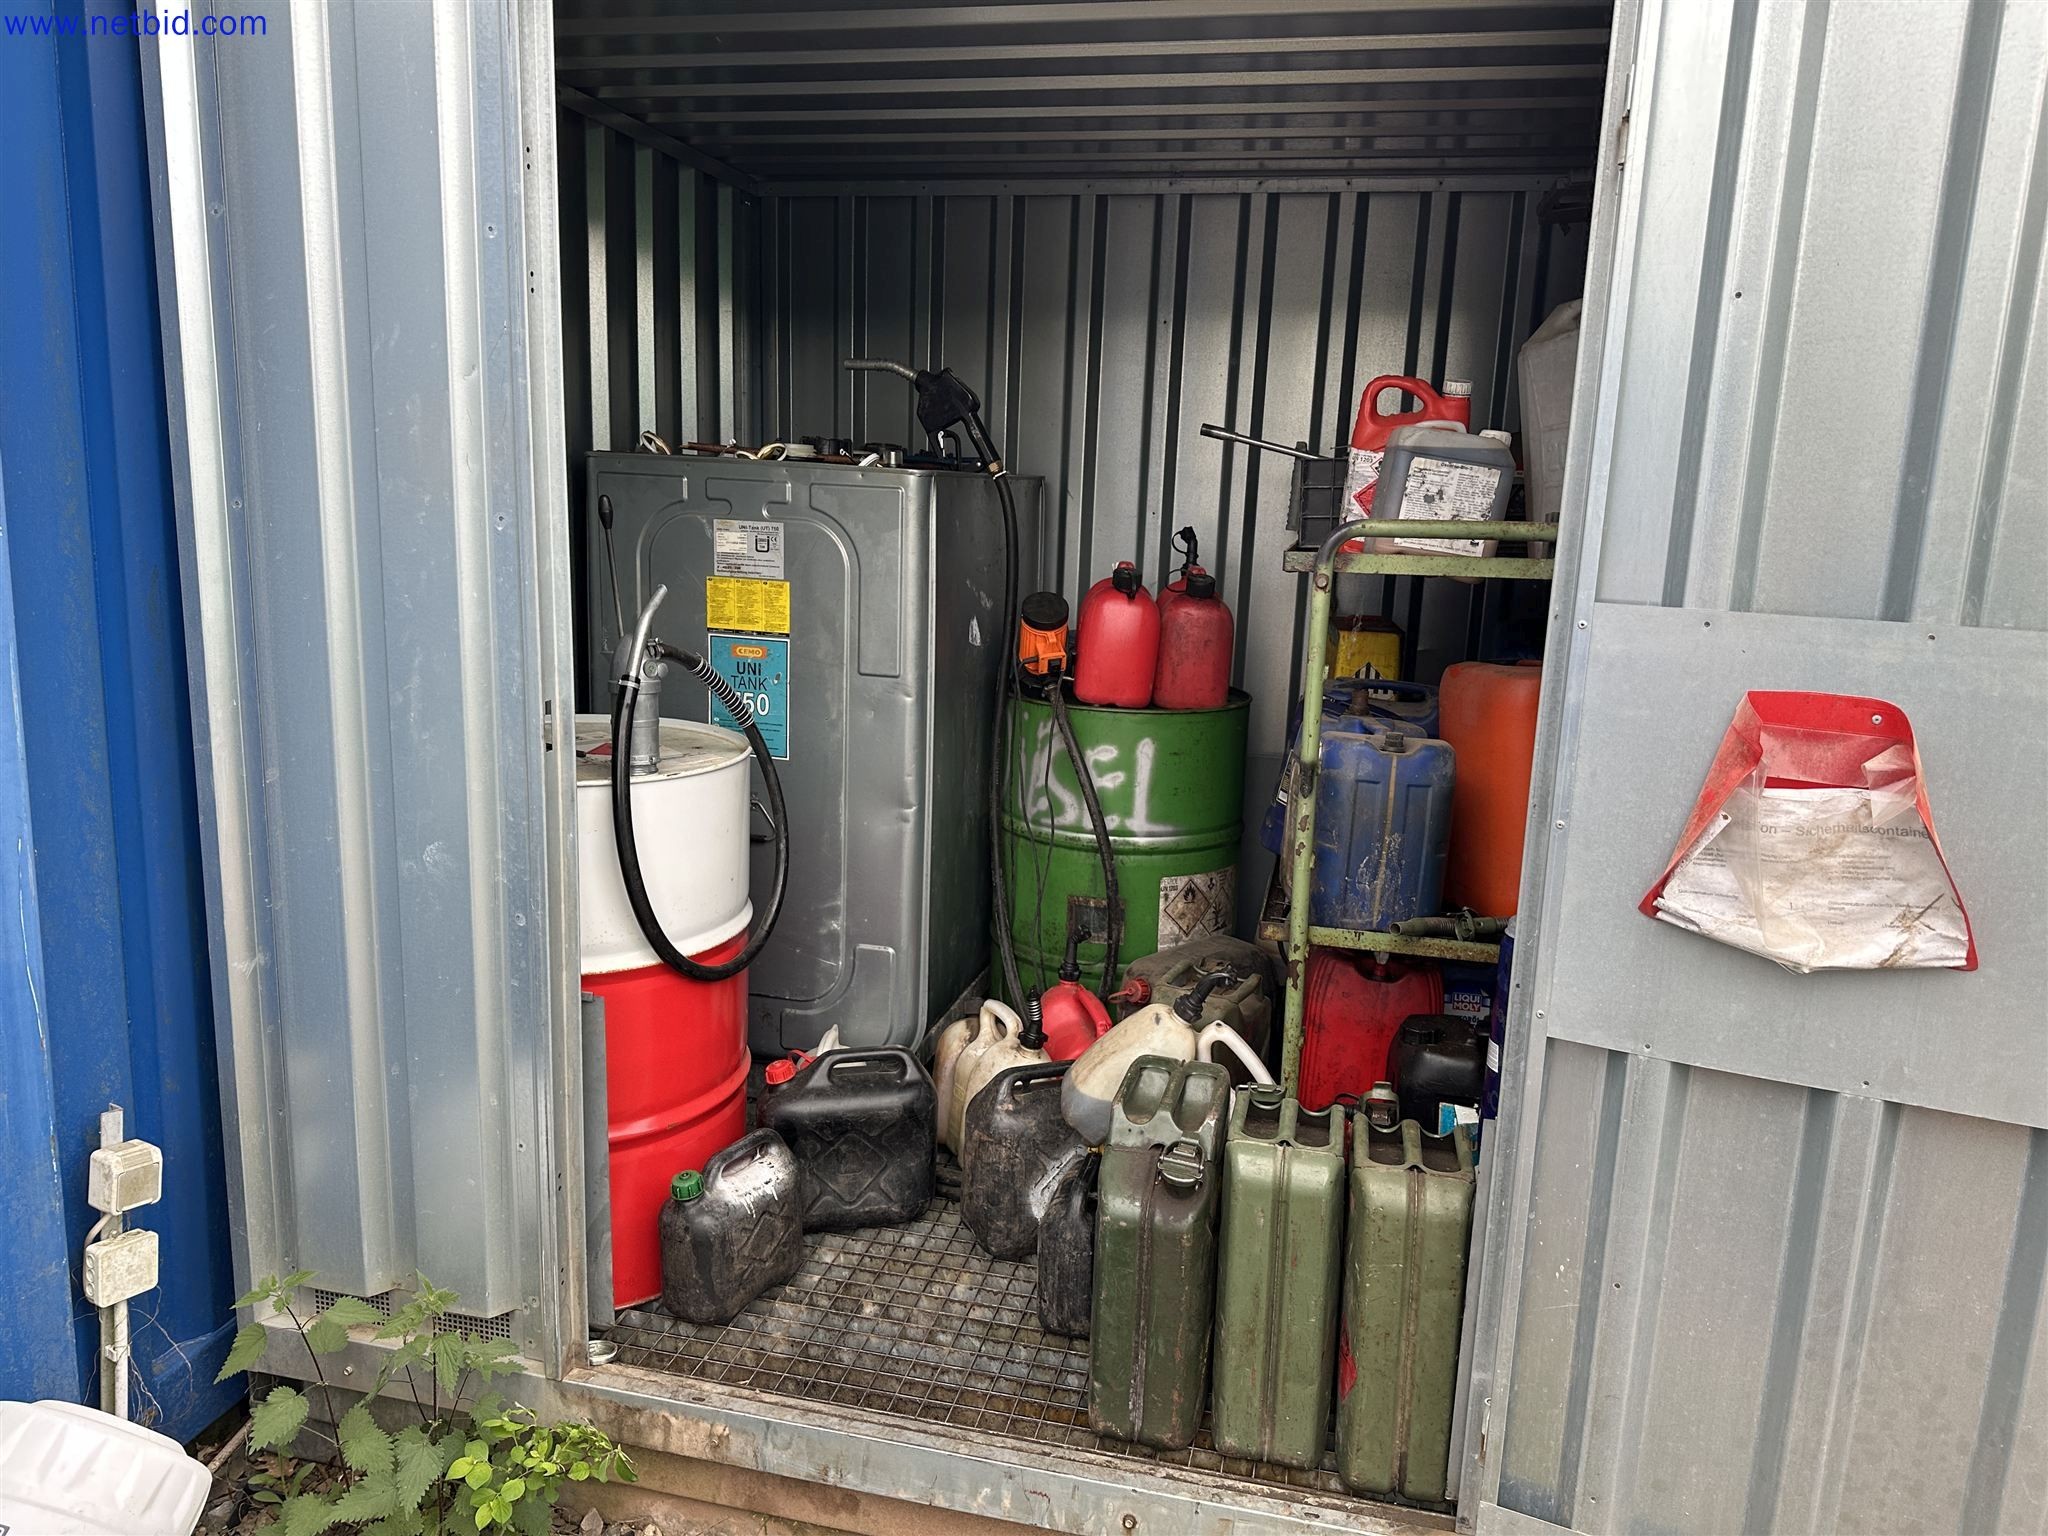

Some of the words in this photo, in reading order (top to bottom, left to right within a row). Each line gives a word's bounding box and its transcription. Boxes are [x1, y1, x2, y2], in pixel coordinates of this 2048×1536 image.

[738, 648, 760, 656] CEMO
[736, 661, 762, 676] UNI
[731, 675, 768, 691] TANK
[1795, 822, 1930, 840] Sicherheitscontaine
[1454, 993, 1480, 1003] LIQUI
[1453, 1002, 1480, 1012] MOLY
